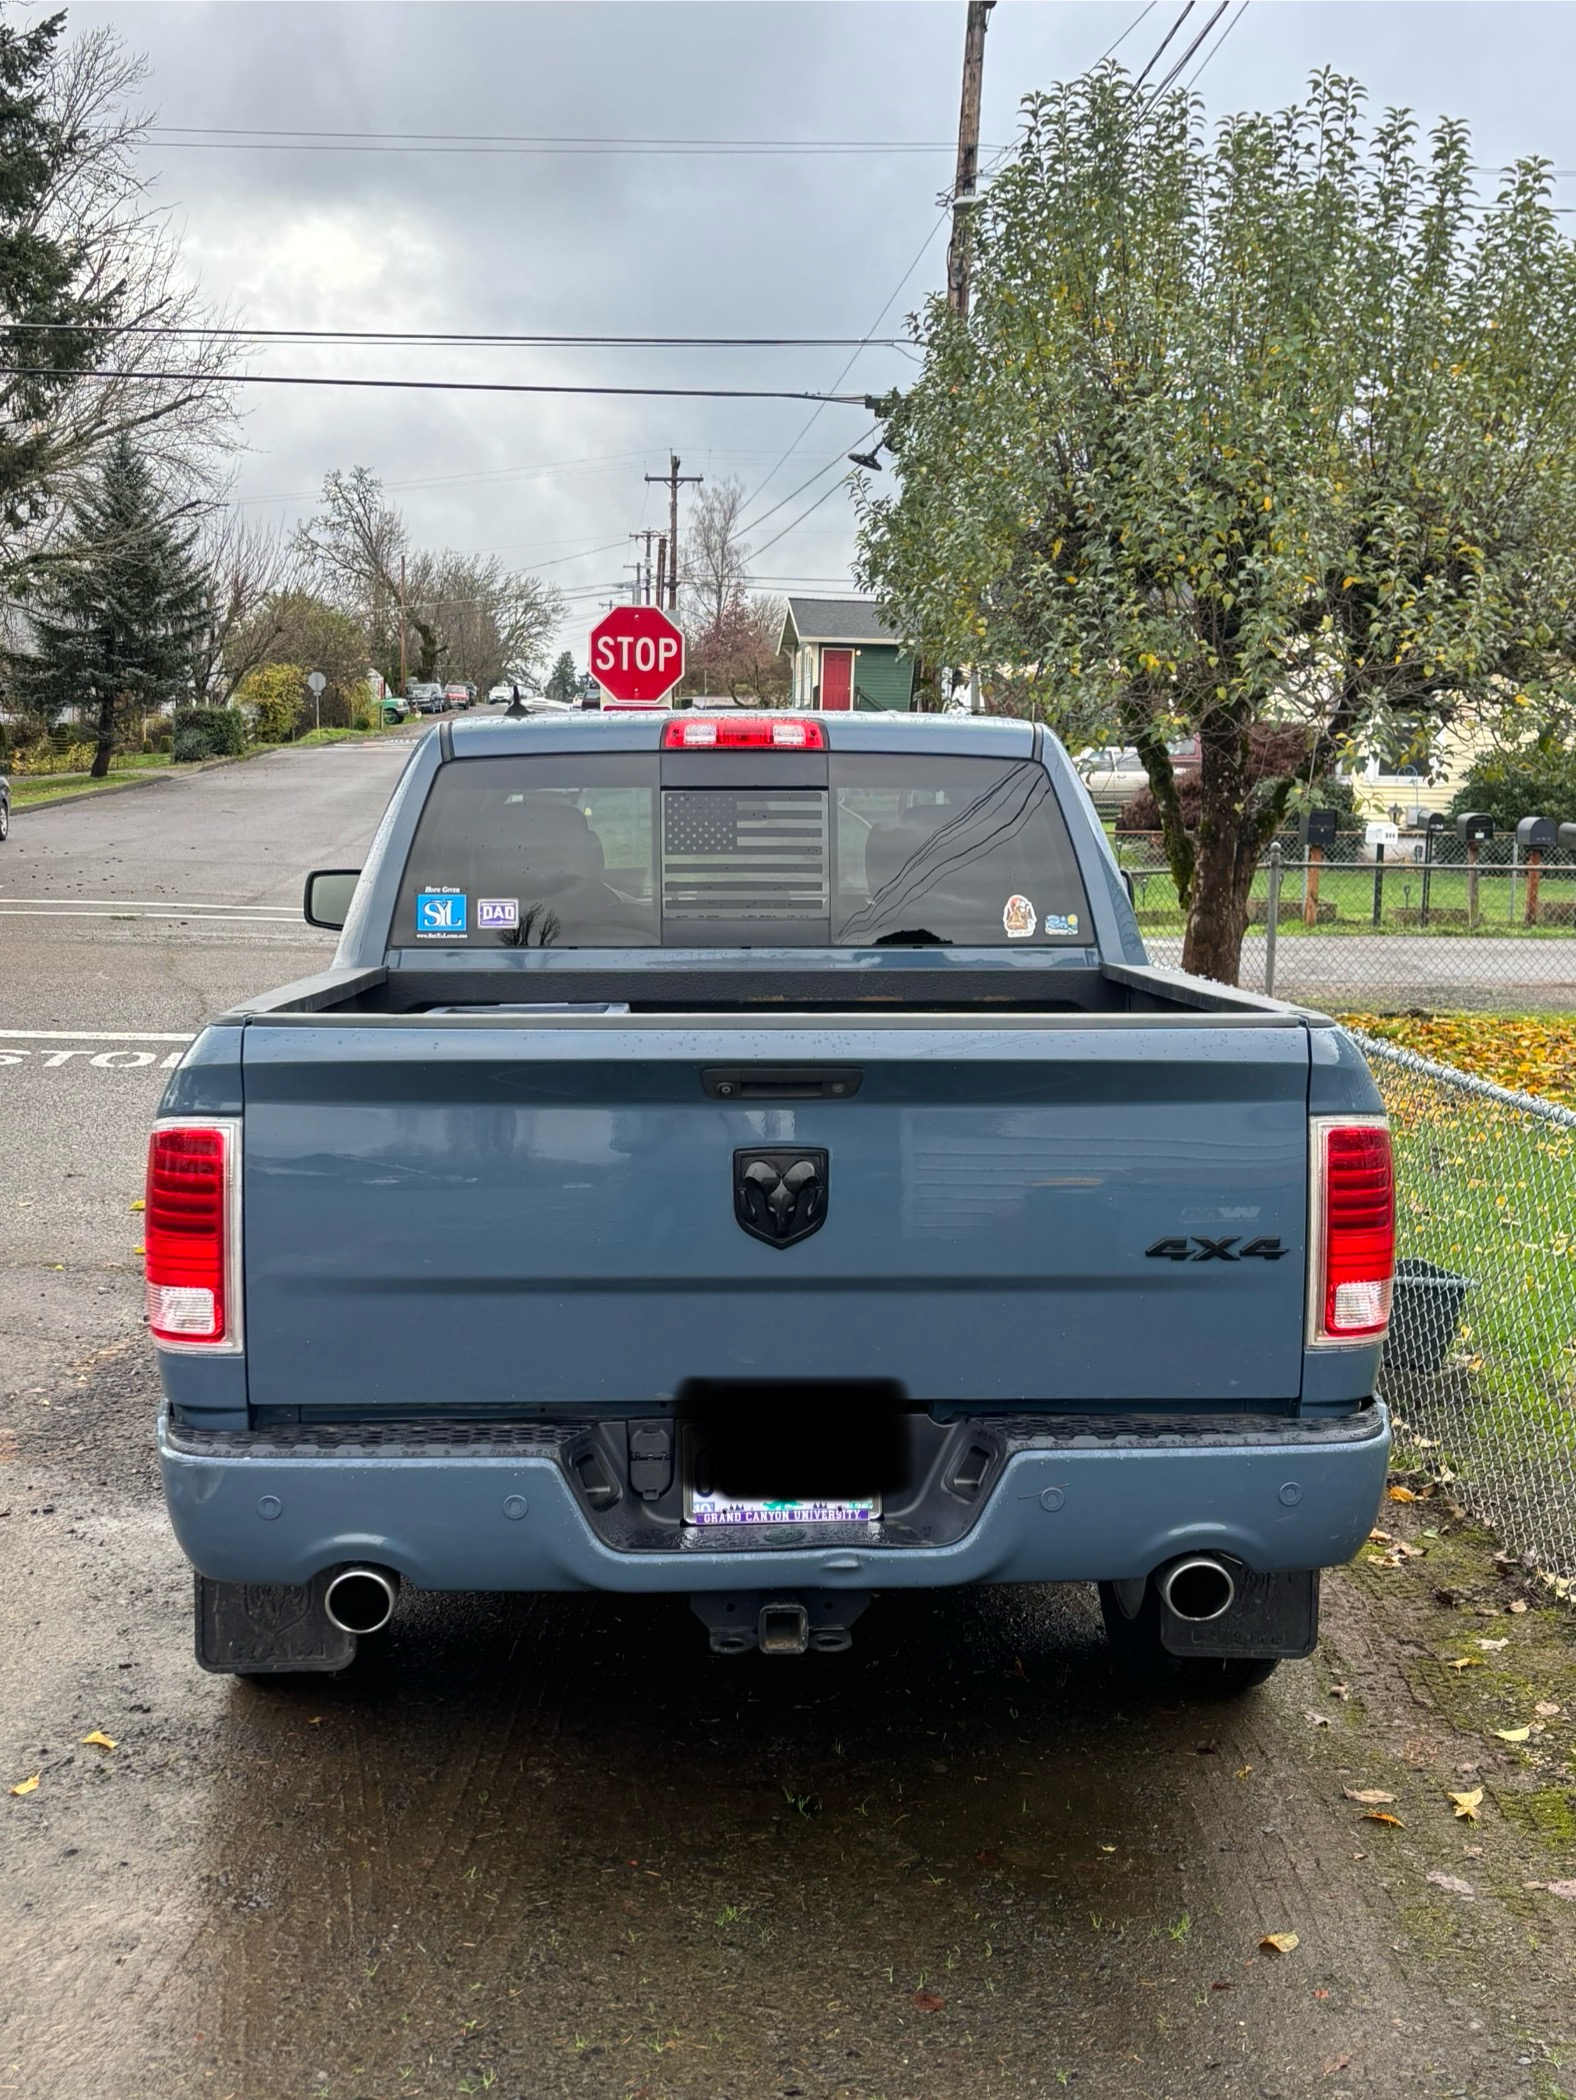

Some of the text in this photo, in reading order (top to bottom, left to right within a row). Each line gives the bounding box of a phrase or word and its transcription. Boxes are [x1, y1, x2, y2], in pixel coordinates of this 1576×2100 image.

[596, 636, 678, 672] STOP
[483, 906, 515, 920] DAD
[1145, 1236, 1290, 1261] 4X4
[704, 1509, 861, 1523] GRAND CANYON UNIVERSITY
